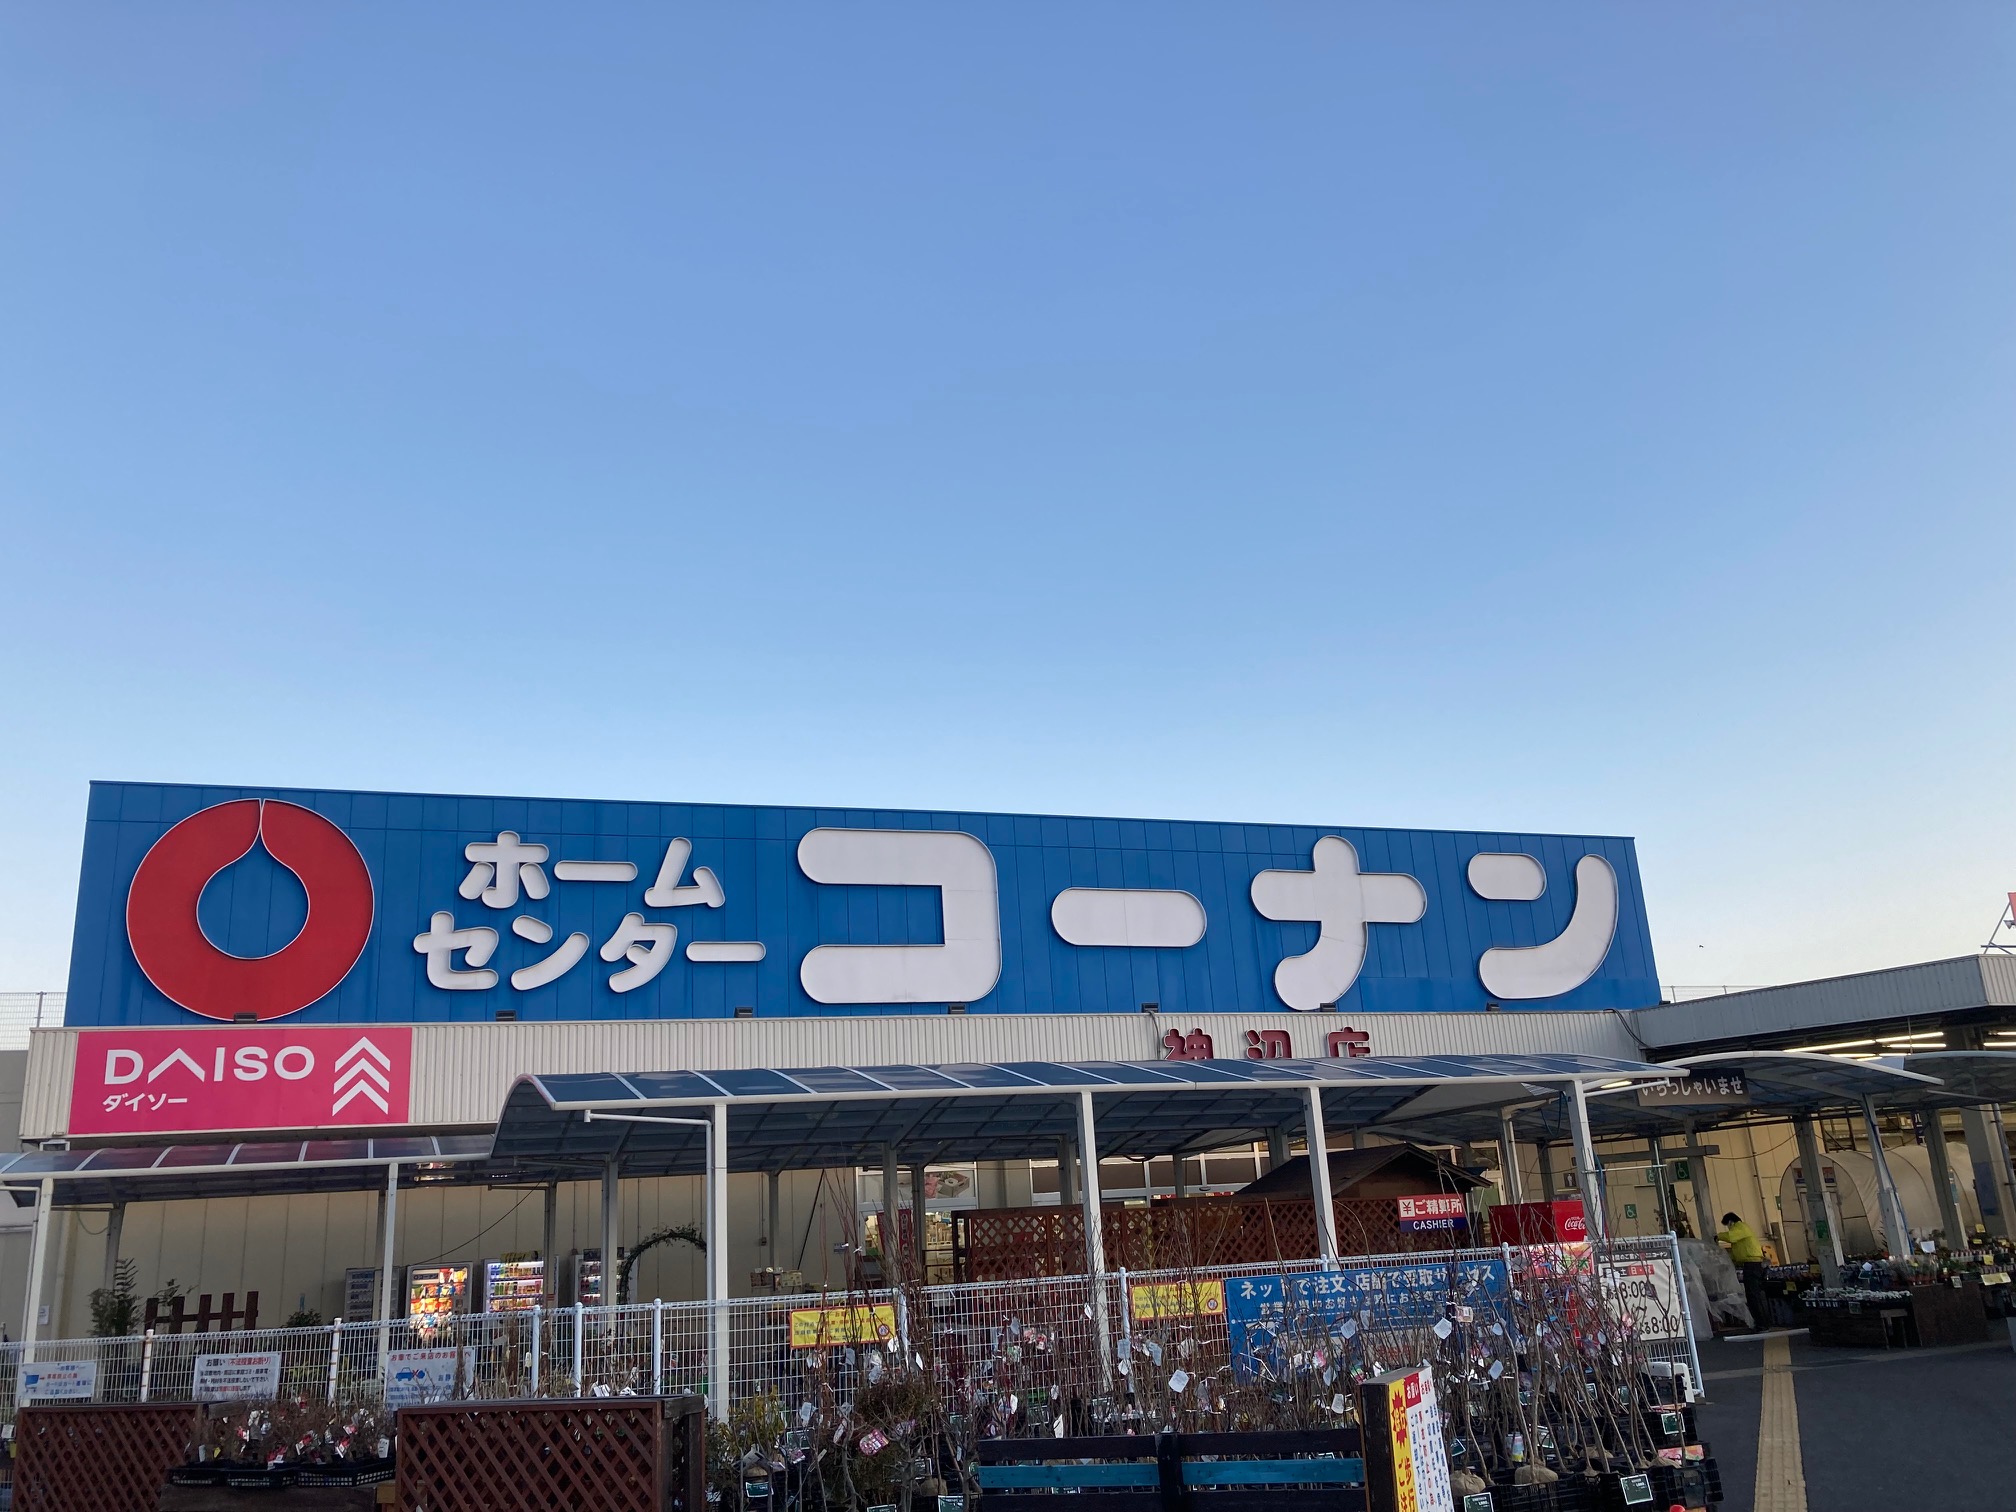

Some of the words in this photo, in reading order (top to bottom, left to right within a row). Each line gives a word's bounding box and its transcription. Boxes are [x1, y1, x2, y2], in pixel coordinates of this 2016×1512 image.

[459, 831, 726, 908] ホーム
[797, 826, 1618, 1011] コーナン
[413, 911, 766, 993] センター
[104, 1045, 315, 1085] DAISO
[1641, 1076, 1743, 1097] いらっしゃいませ
[103, 1092, 188, 1112] ダイソー
[1415, 1199, 1462, 1215] ご精算所
[1413, 1219, 1455, 1230] CASHIER
